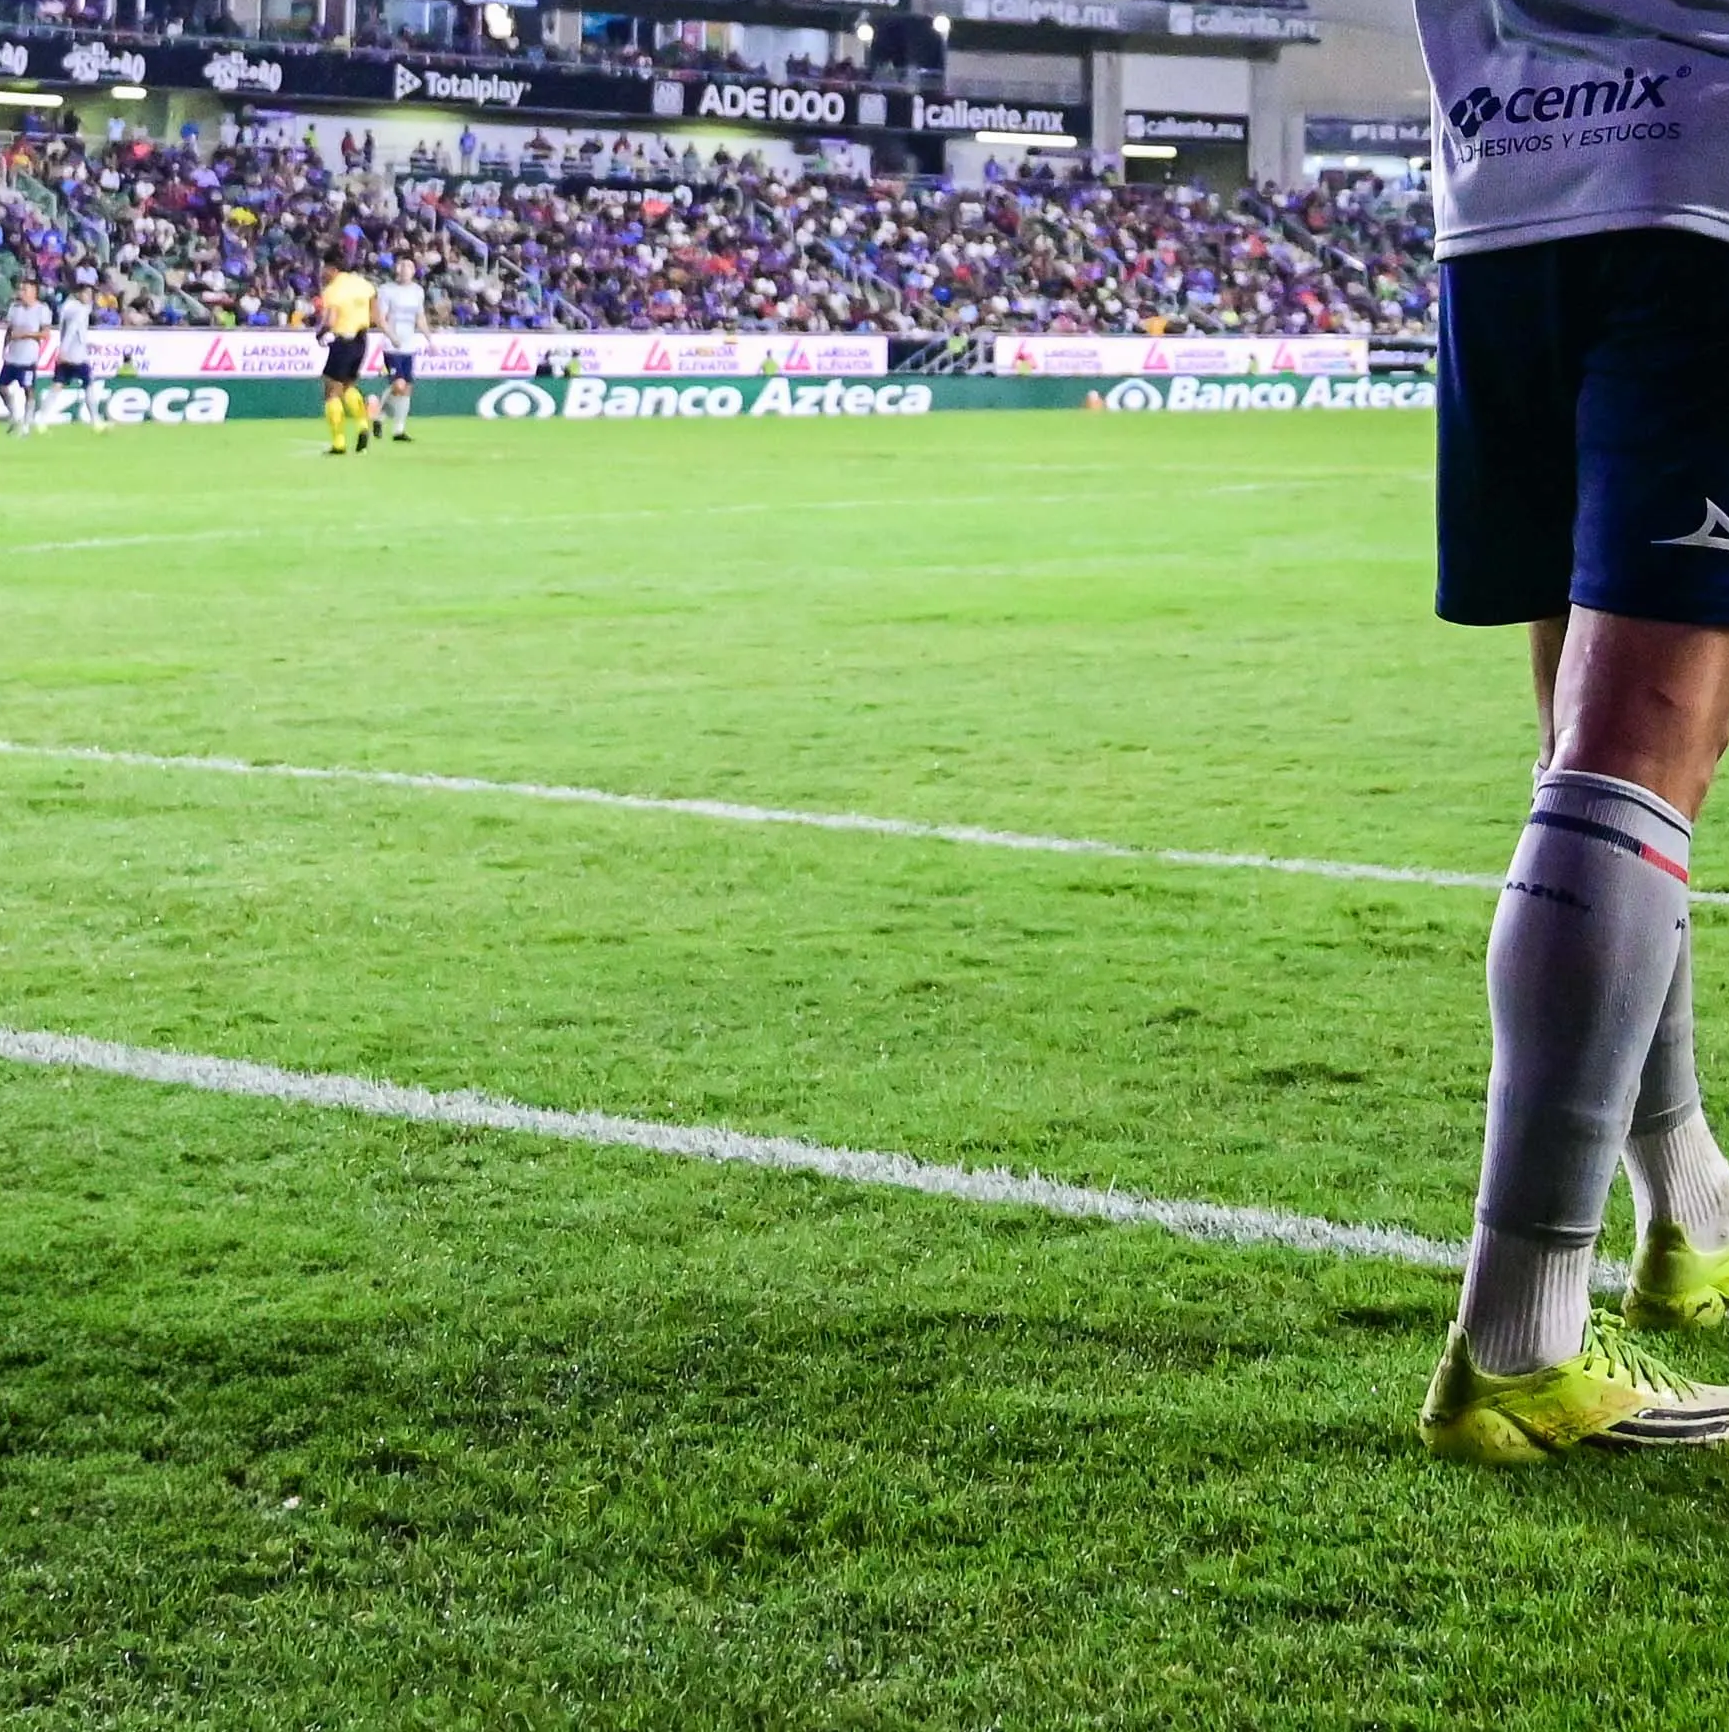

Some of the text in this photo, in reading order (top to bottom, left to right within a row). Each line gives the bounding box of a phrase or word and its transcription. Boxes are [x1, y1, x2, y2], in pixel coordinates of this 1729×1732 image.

[424, 72, 524, 106] Totalplay
[1505, 67, 1669, 123] cemix
[926, 99, 1064, 133] caliente.mx
[1563, 133, 1574, 149] Y
[1580, 122, 1682, 146] ESTUCOS
[242, 345, 310, 357] LARSSON
[242, 360, 314, 372] ELEVATOR
[562, 376, 933, 417] Banco Azteca
[1170, 376, 1436, 410] Banco Azteca
